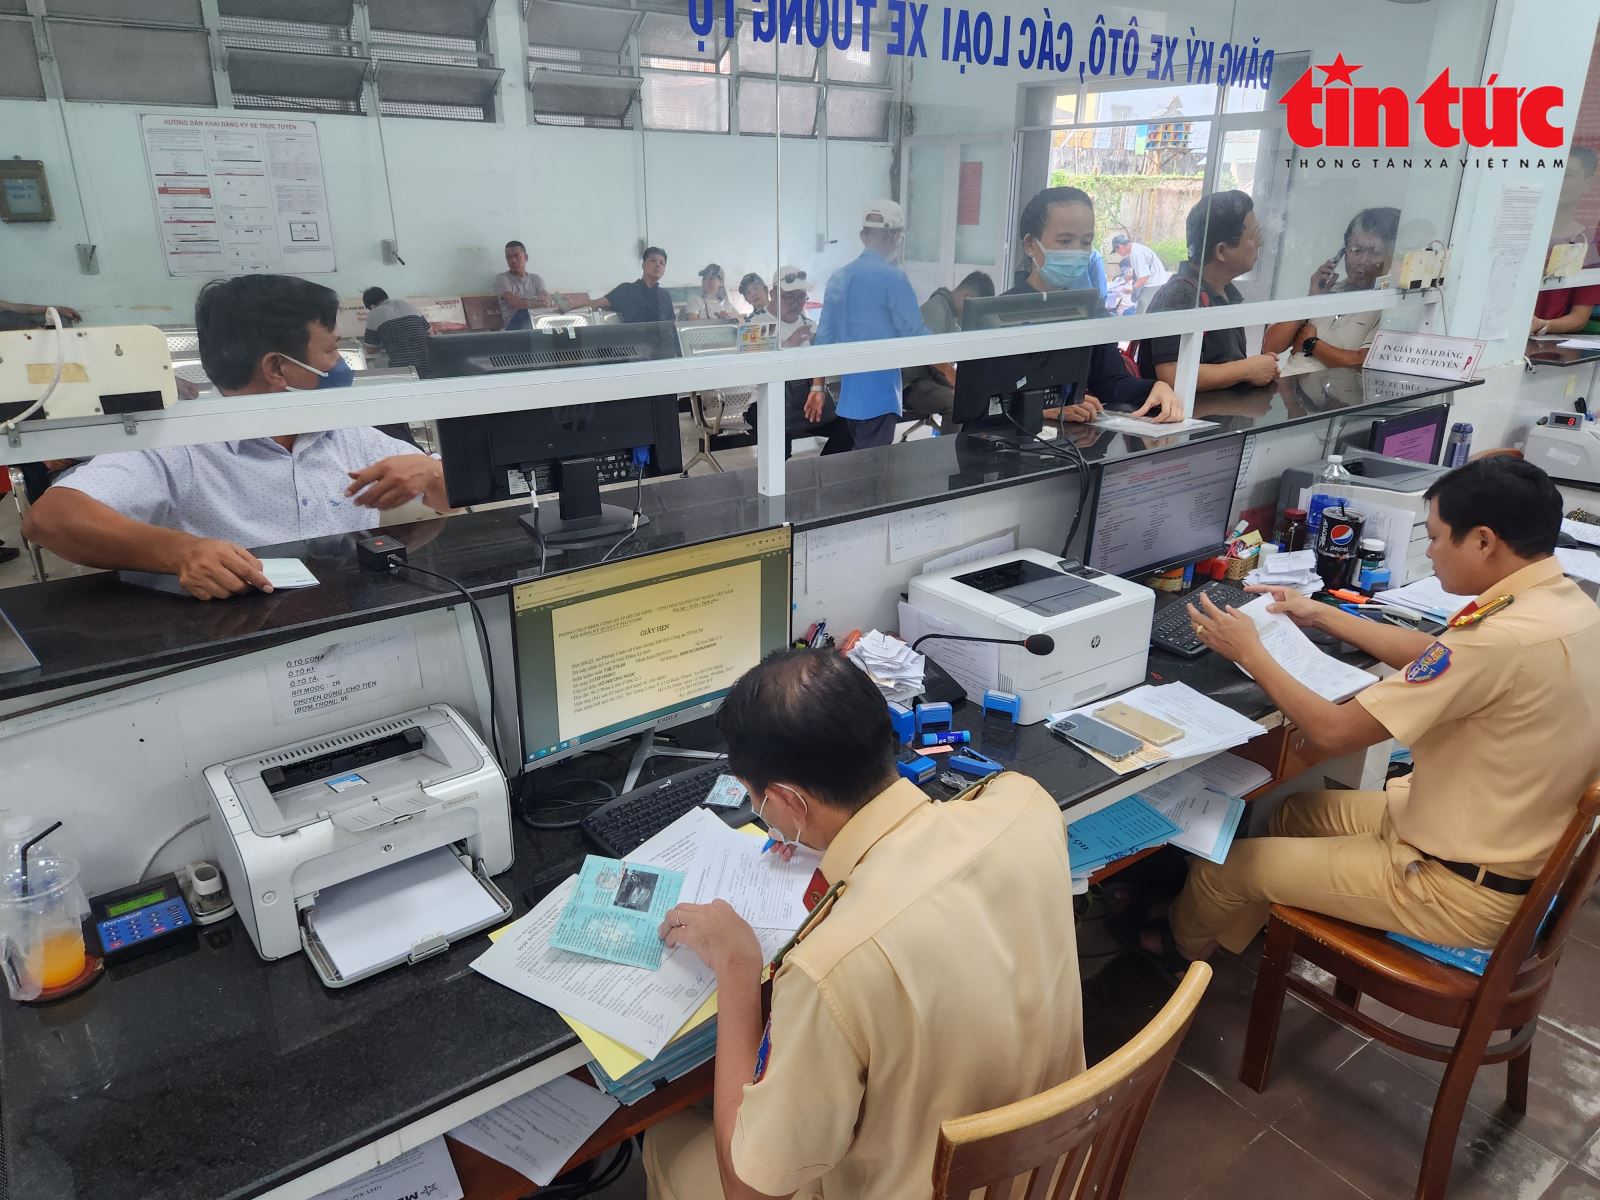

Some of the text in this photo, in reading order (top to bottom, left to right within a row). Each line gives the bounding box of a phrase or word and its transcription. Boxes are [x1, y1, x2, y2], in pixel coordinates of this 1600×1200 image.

[1393, 344, 1414, 354] GIẤY
[1415, 347, 1437, 356] KHAI
[1379, 353, 1391, 361] KÝ
[1406, 356, 1428, 365] TRỰC
[1430, 359, 1459, 369] TUYẾN
[639, 625, 655, 637] GIẤY
[1471, 954, 1482, 965] A
